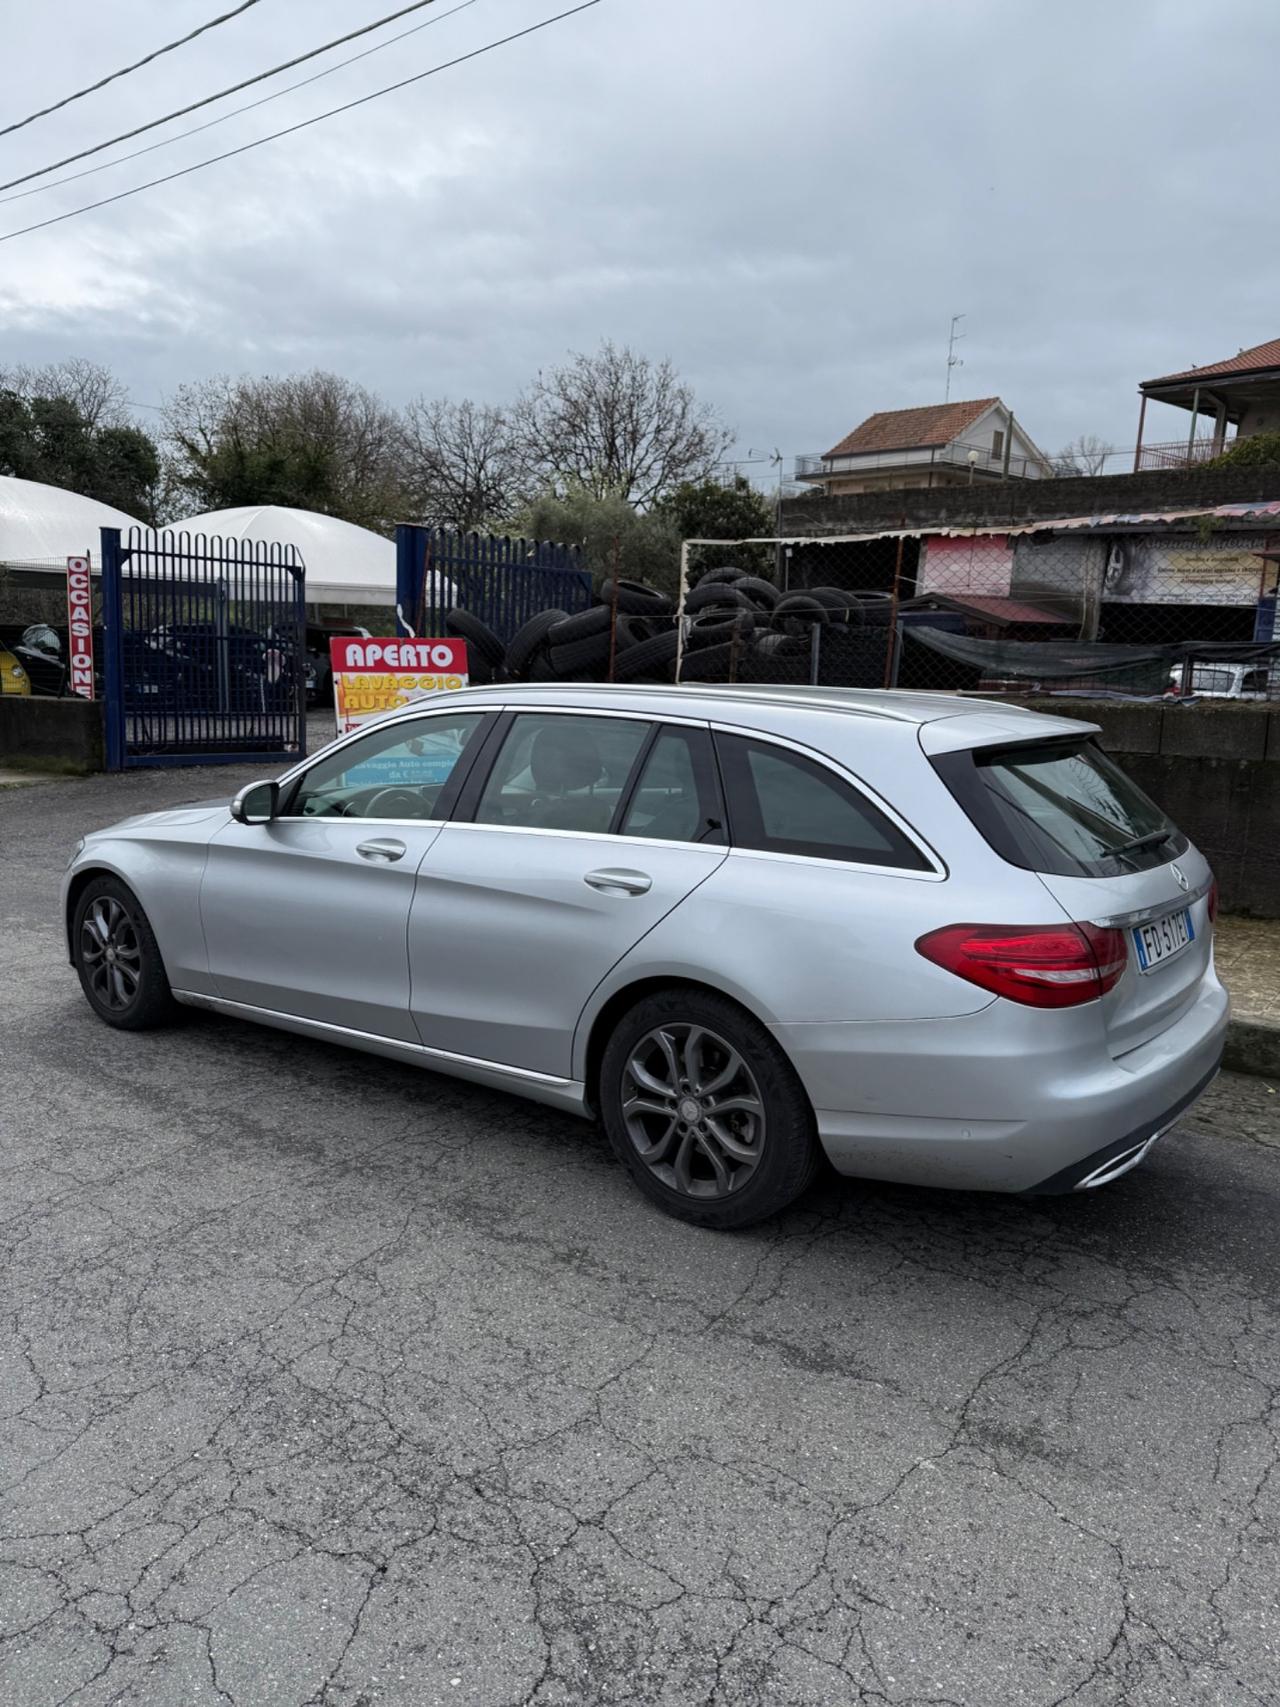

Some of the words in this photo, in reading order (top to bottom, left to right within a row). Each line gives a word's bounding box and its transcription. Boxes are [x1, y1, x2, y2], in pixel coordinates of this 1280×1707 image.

[68, 558, 92, 699] OCCASIONE
[345, 644, 453, 667] APERTO
[343, 675, 462, 690] LAVAGGIO
[344, 695, 408, 710] AUTO
